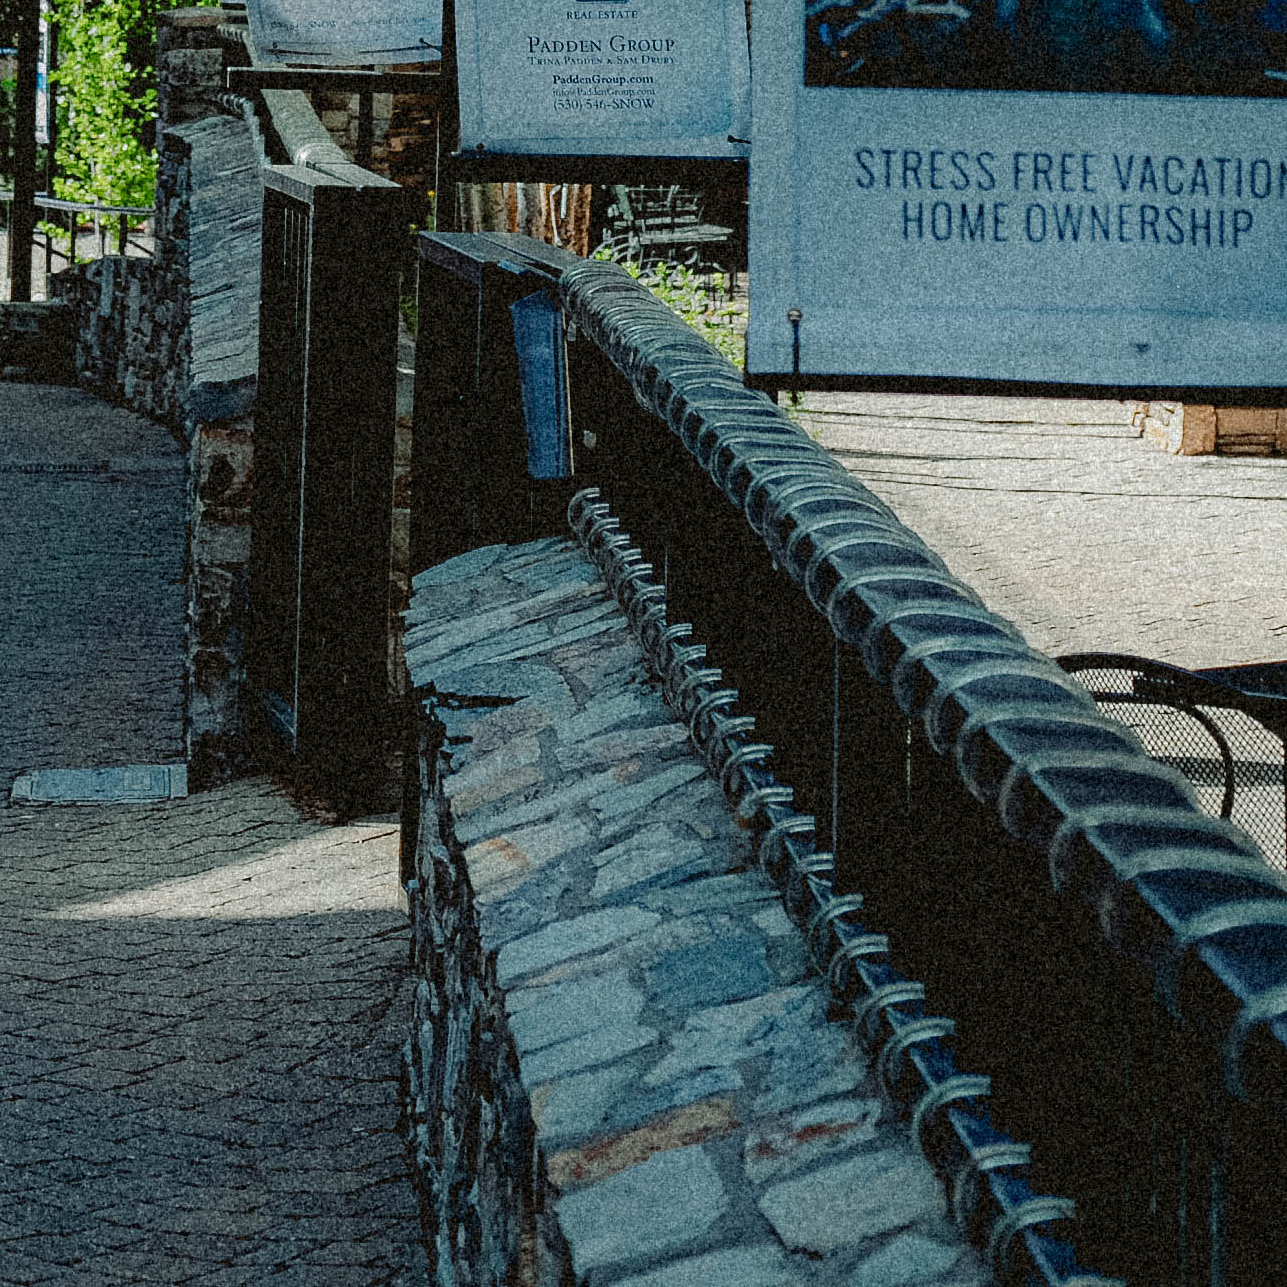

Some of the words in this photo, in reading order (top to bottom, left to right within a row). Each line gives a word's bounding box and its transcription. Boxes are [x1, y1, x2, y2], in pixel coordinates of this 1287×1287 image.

[566, 10, 593, 20] REAL
[598, 10, 639, 20] ESTATE
[528, 36, 603, 54] PADDEN
[609, 34, 675, 53] GROUP
[553, 74, 654, 86] PaddenGroup.com
[553, 98, 583, 111] (530)
[585, 98, 655, 110] 546-SNOW
[854, 148, 997, 192] STRESS
[1013, 151, 1098, 193] FREE
[902, 200, 1010, 243] HOME
[1025, 202, 1254, 248] OWNERSHIP
